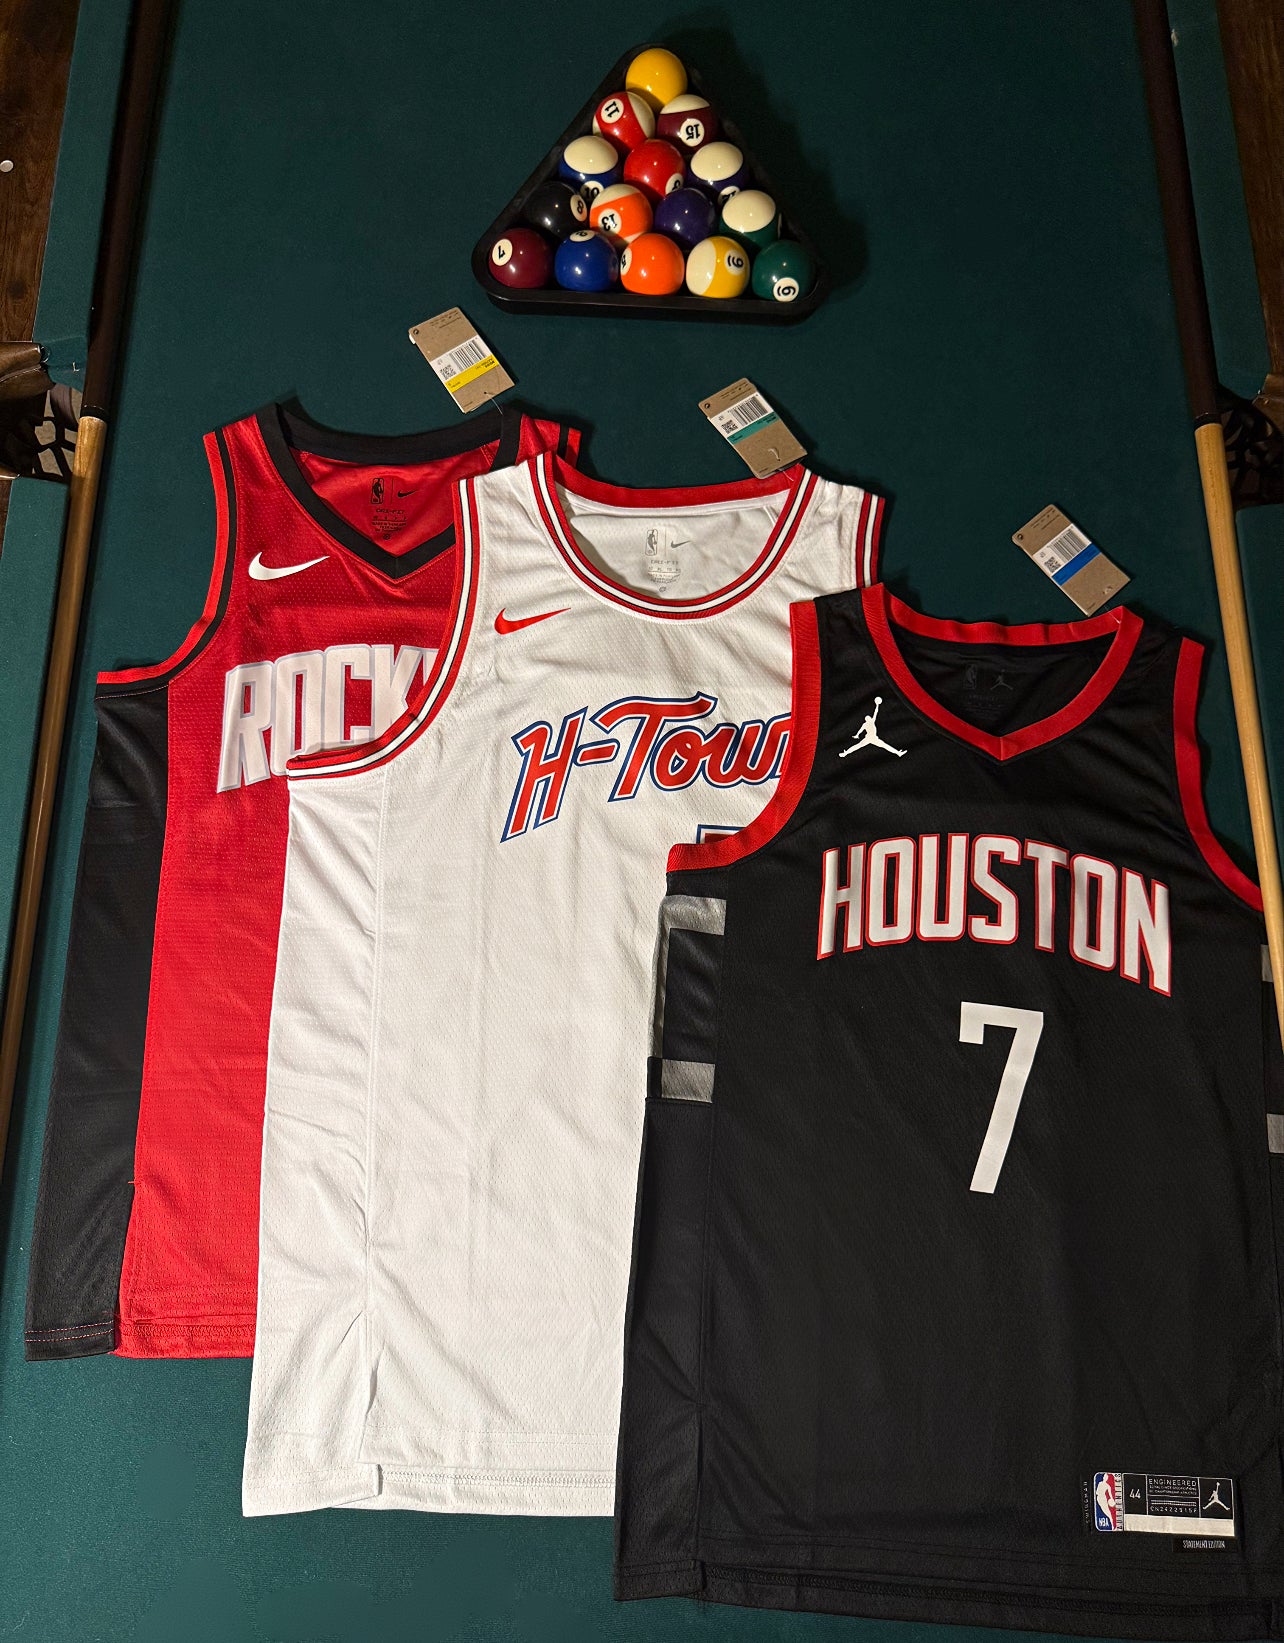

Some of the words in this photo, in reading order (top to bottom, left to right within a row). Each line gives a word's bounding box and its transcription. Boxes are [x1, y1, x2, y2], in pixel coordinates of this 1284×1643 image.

[604, 100, 620, 118] 11
[685, 123, 701, 141] 15
[584, 187, 600, 200] 10
[576, 200, 584, 214] 8
[601, 213, 618, 232] 13
[498, 245, 506, 260] 7
[217, 643, 440, 793] ROCK
[817, 833, 1171, 997] HOUSTON
[959, 1001, 1044, 1194] 7
[1148, 1478, 1197, 1487] ENGINEERED
[1129, 1488, 1141, 1499] 44
[1098, 1517, 1110, 1527] NBA
